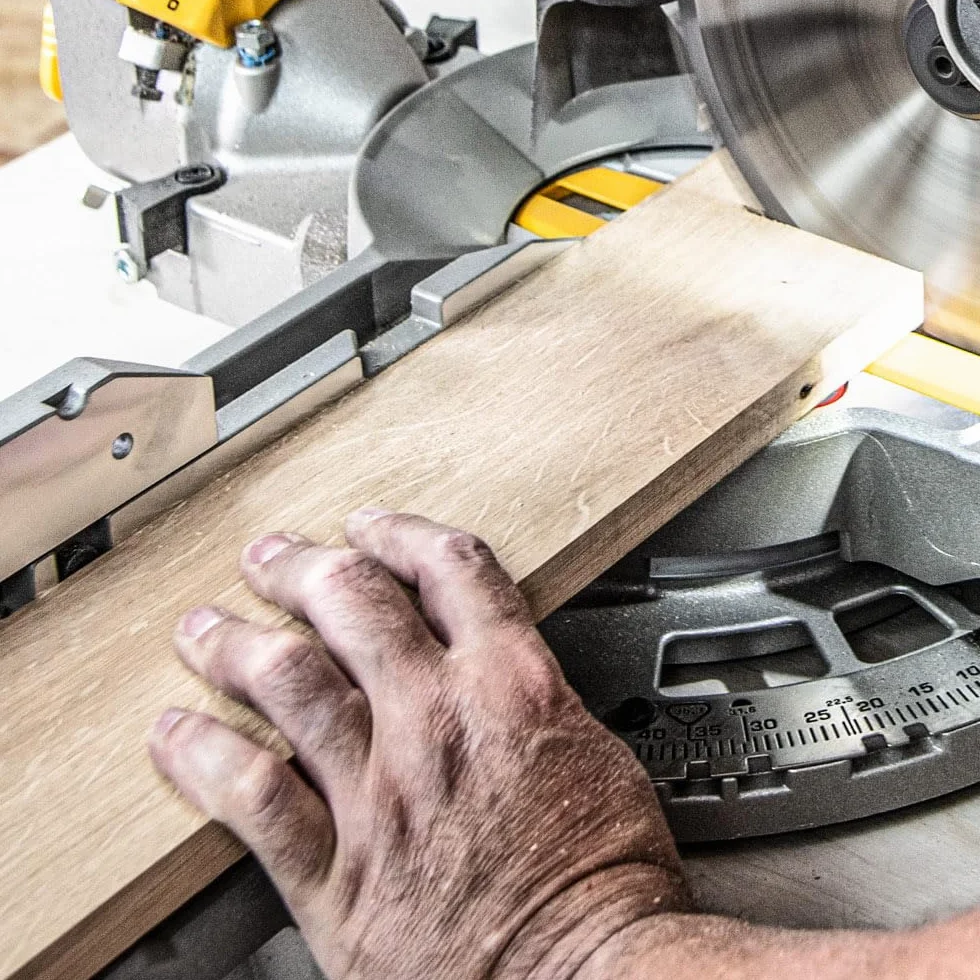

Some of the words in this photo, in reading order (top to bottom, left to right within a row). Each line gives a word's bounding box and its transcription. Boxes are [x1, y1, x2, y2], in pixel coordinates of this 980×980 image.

[639, 728, 666, 740] 40
[694, 725, 722, 737] 35
[749, 718, 778, 731] 30
[803, 709, 832, 724] 25
[856, 697, 885, 712] 20
[908, 682, 935, 696] 15
[825, 695, 854, 707] 22.5
